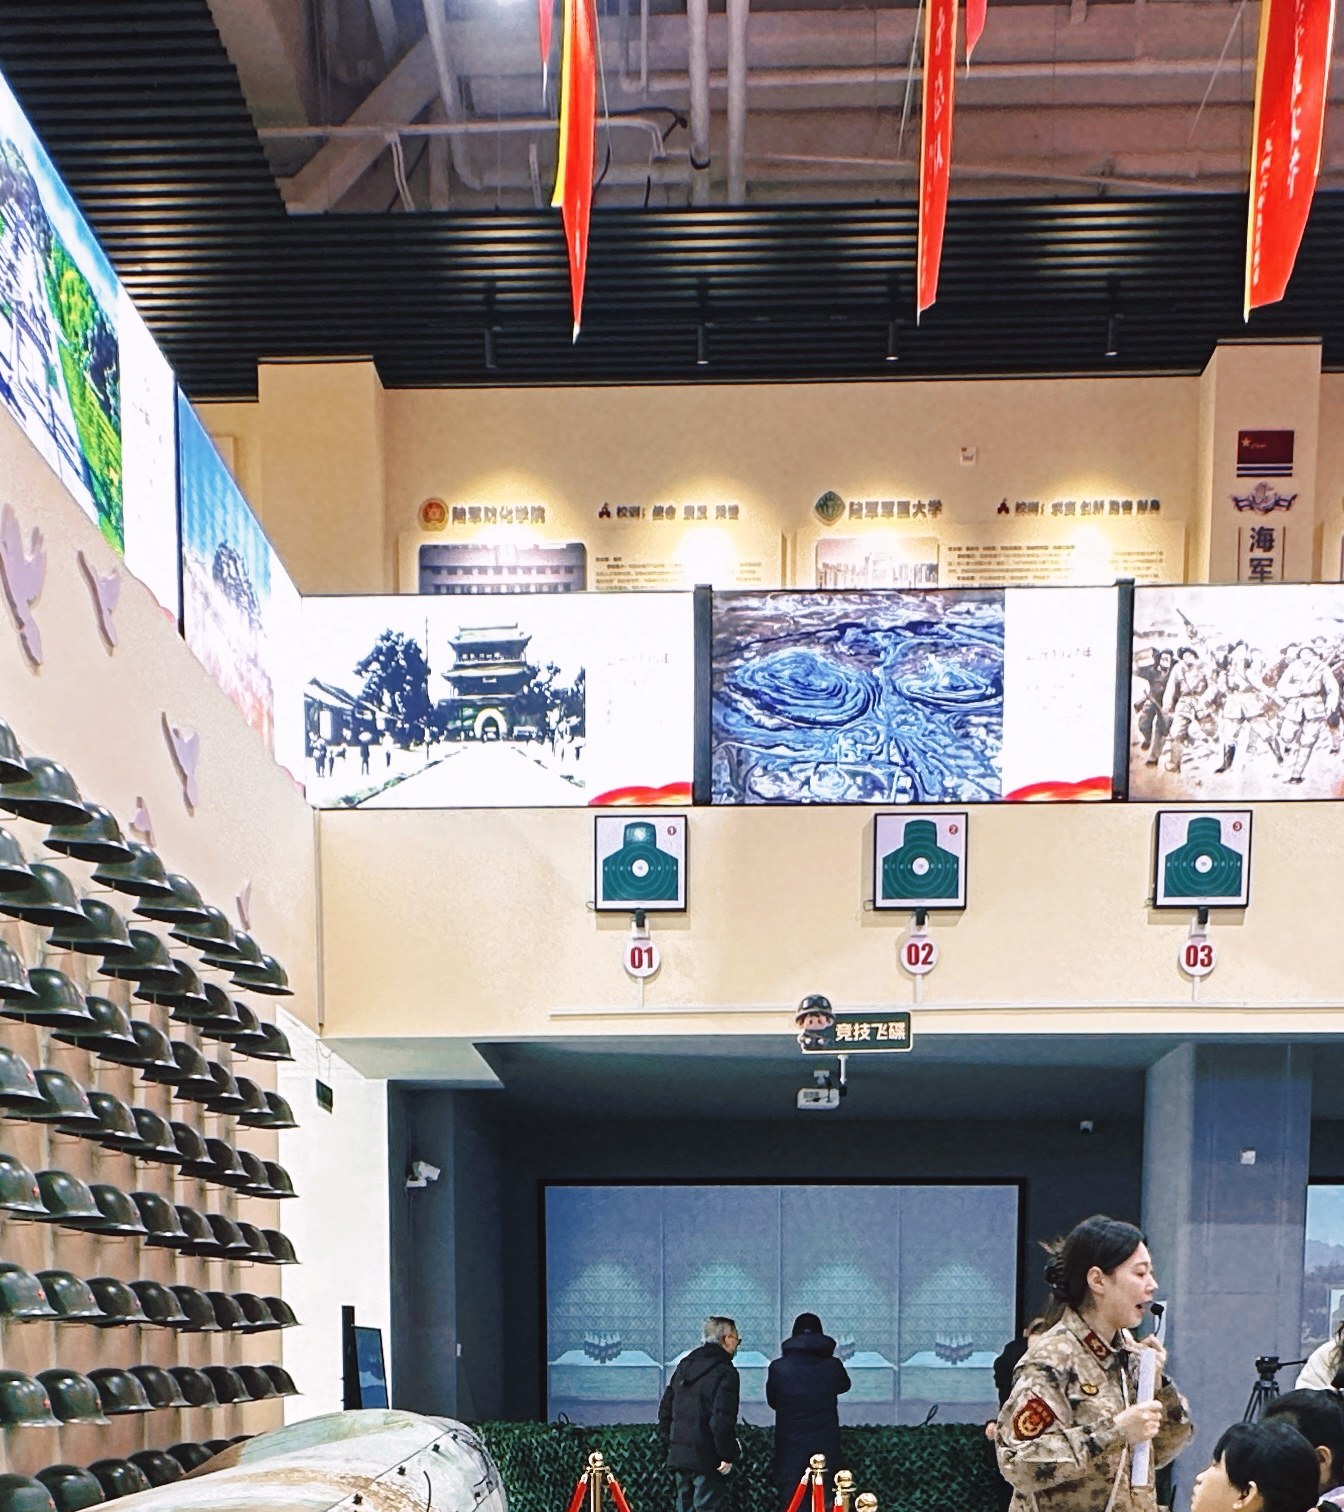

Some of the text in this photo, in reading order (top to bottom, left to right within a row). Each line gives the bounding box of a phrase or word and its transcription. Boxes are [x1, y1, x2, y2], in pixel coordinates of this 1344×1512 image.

[1248, 526, 1276, 582] 海军
[629, 945, 654, 970] 01
[906, 942, 934, 967] 02
[1185, 943, 1213, 968] 03
[835, 1021, 906, 1042] 竞技飞碟
